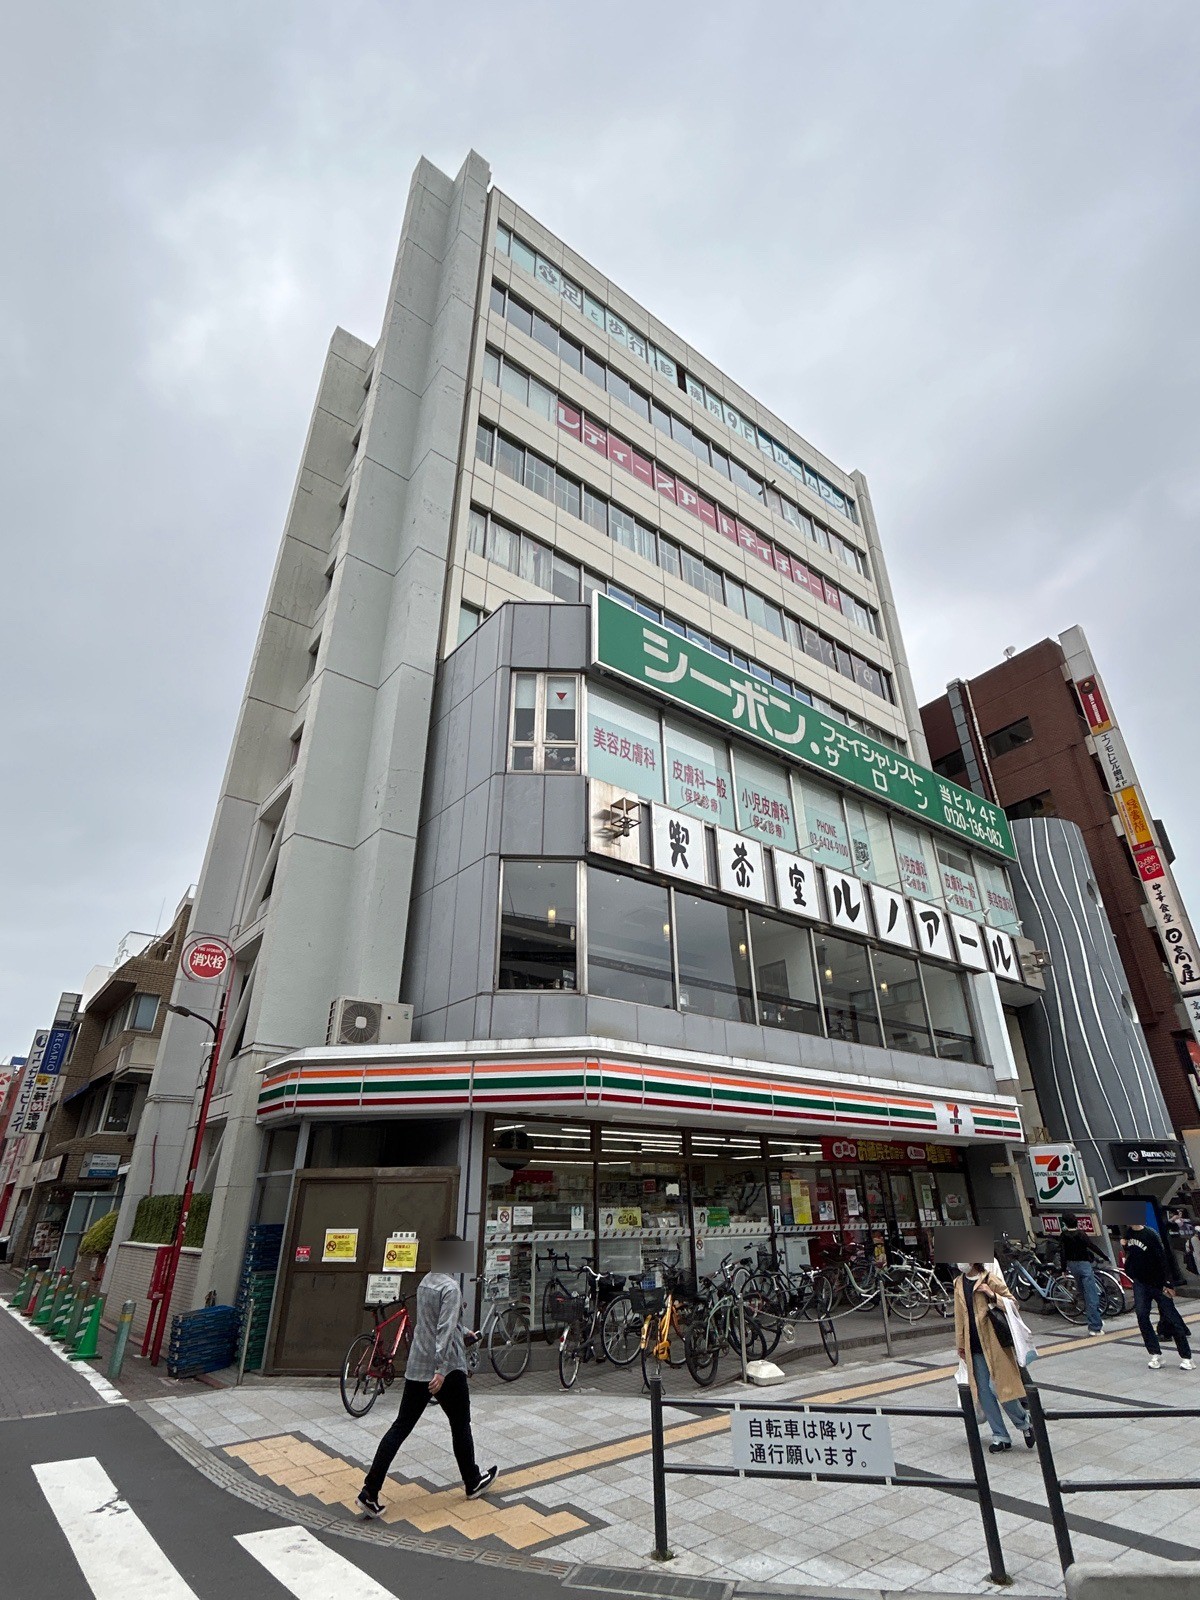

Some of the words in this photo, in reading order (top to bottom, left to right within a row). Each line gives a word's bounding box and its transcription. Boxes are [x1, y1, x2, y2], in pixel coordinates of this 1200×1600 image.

[593, 725, 657, 772] 美容皮膚科
[820, 721, 924, 787] フェイシャリスト
[672, 759, 728, 800] 皮膚科一般
[742, 787, 790, 823] 小児皮膚科
[816, 818, 838, 838] PHONE
[944, 805, 1005, 849] 0120-136-082
[192, 952, 225, 969] 消火栓
[46, 1031, 65, 1072] REGARIO
[1044, 1218, 1059, 1230] ATM
[749, 1418, 872, 1441] 自転車は降りて
[750, 1444, 867, 1468] 通行願います。
